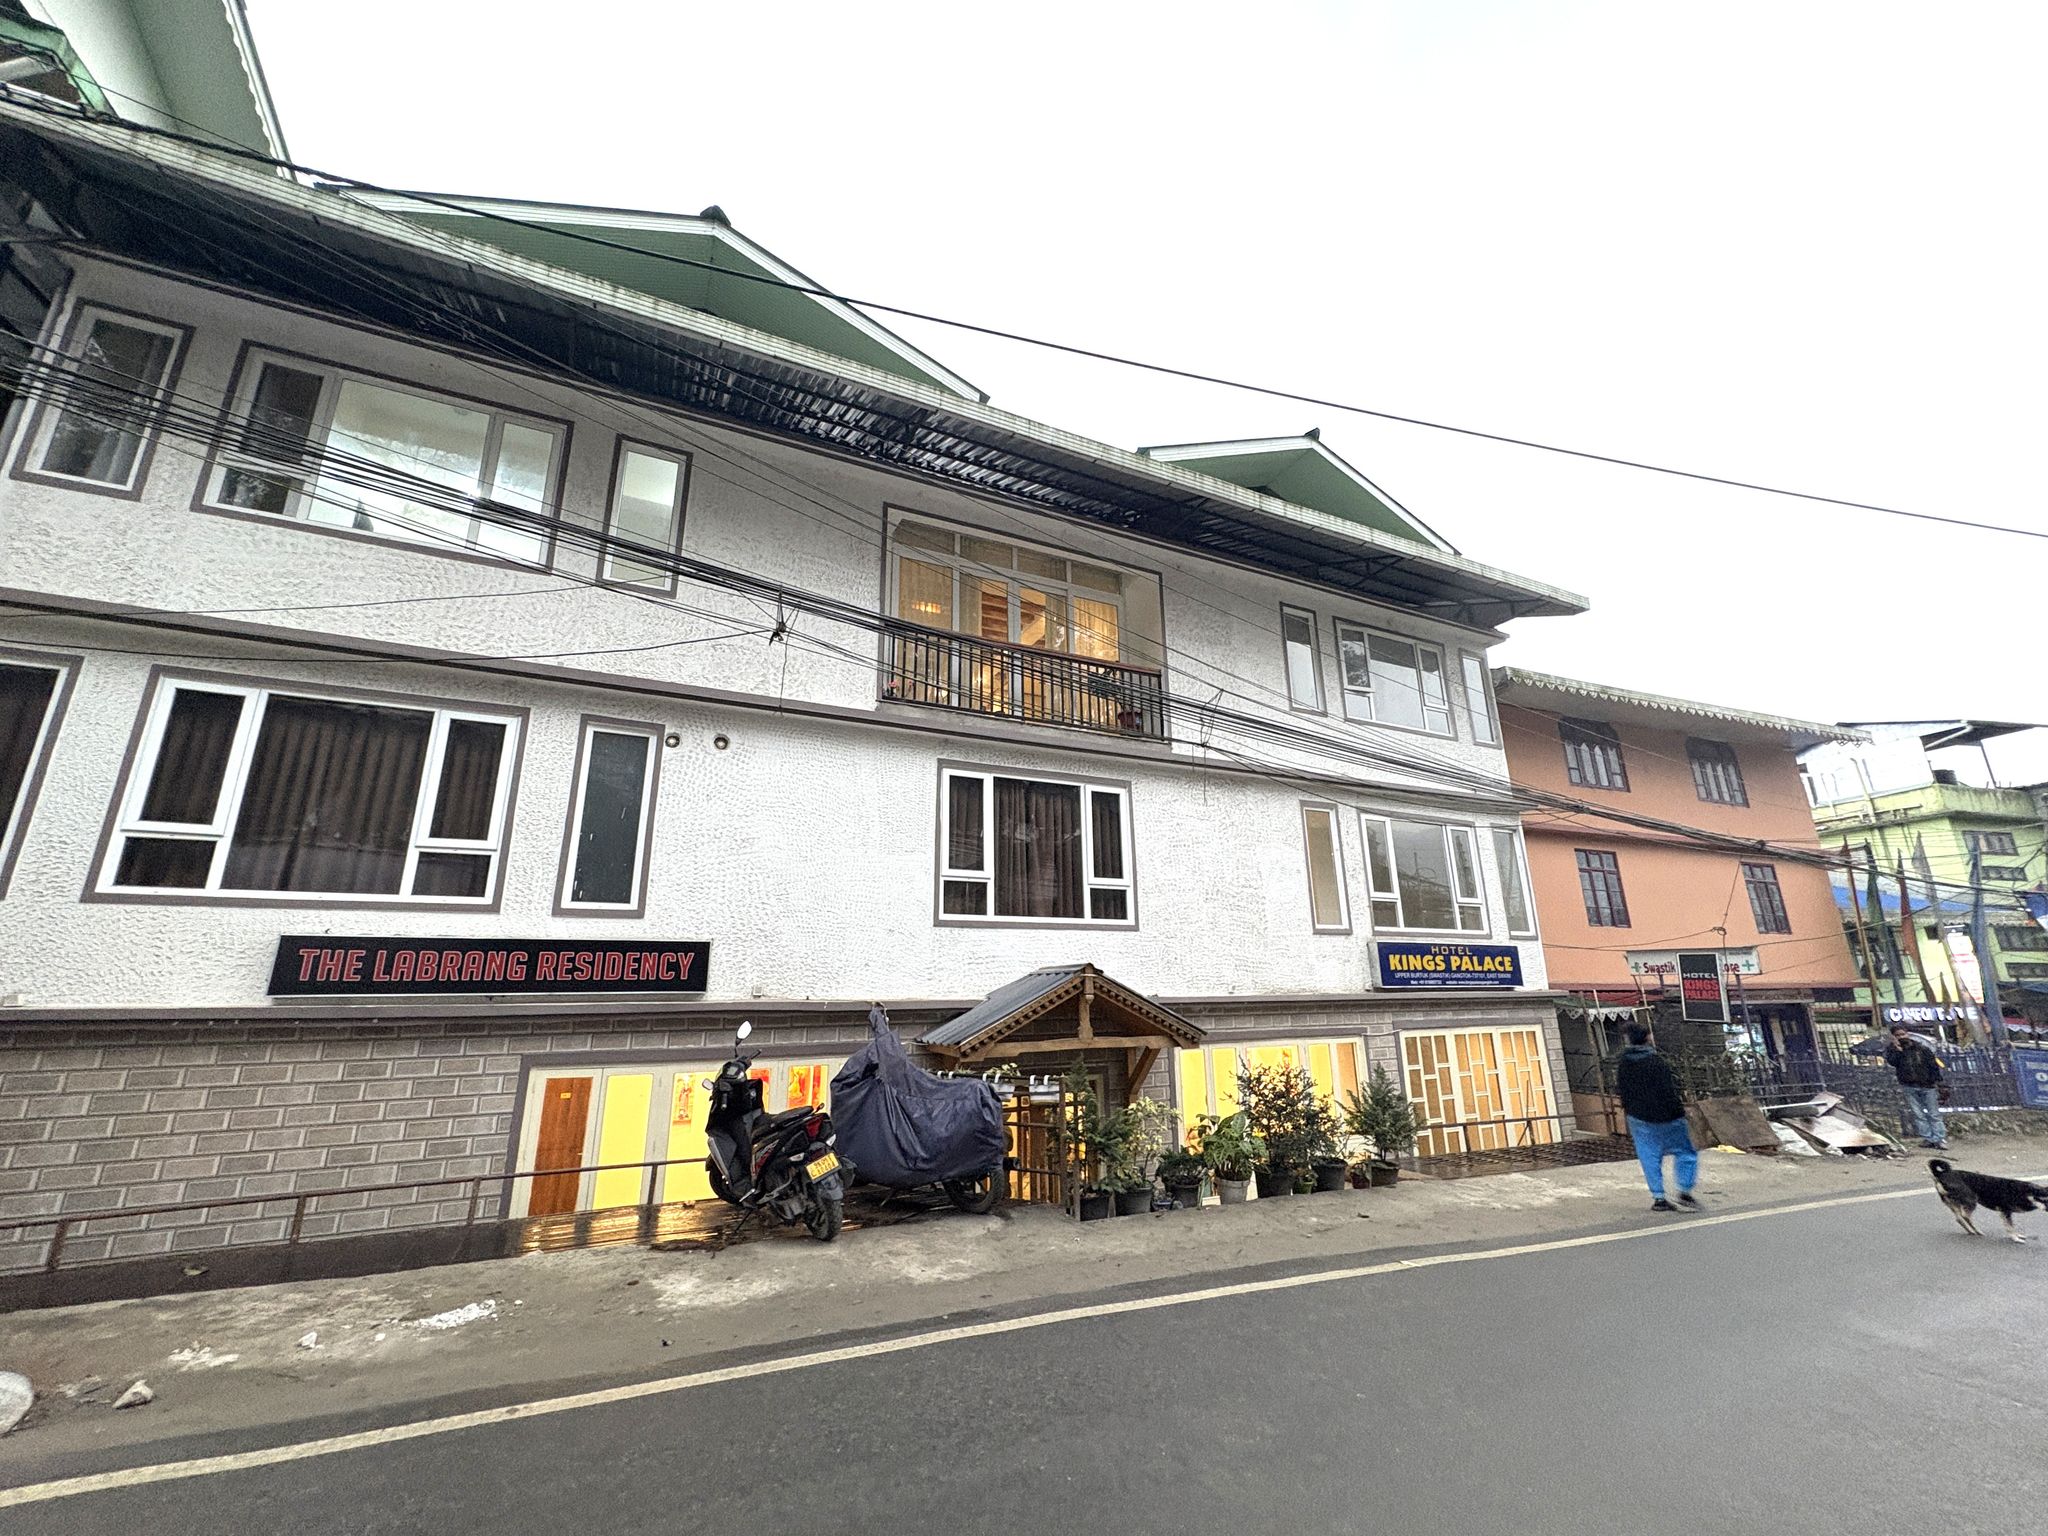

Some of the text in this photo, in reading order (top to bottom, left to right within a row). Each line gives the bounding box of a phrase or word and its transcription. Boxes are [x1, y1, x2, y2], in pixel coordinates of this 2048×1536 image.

[1431, 946, 1473, 955] HOTEL
[299, 949, 696, 982] THE LABRANG RESIDENCY
[1388, 954, 1513, 972] KINGS PALACE
[1643, 960, 1677, 974] Swastik
[1684, 979, 1719, 990] KINGS
[1685, 990, 1720, 1000] PALACE
